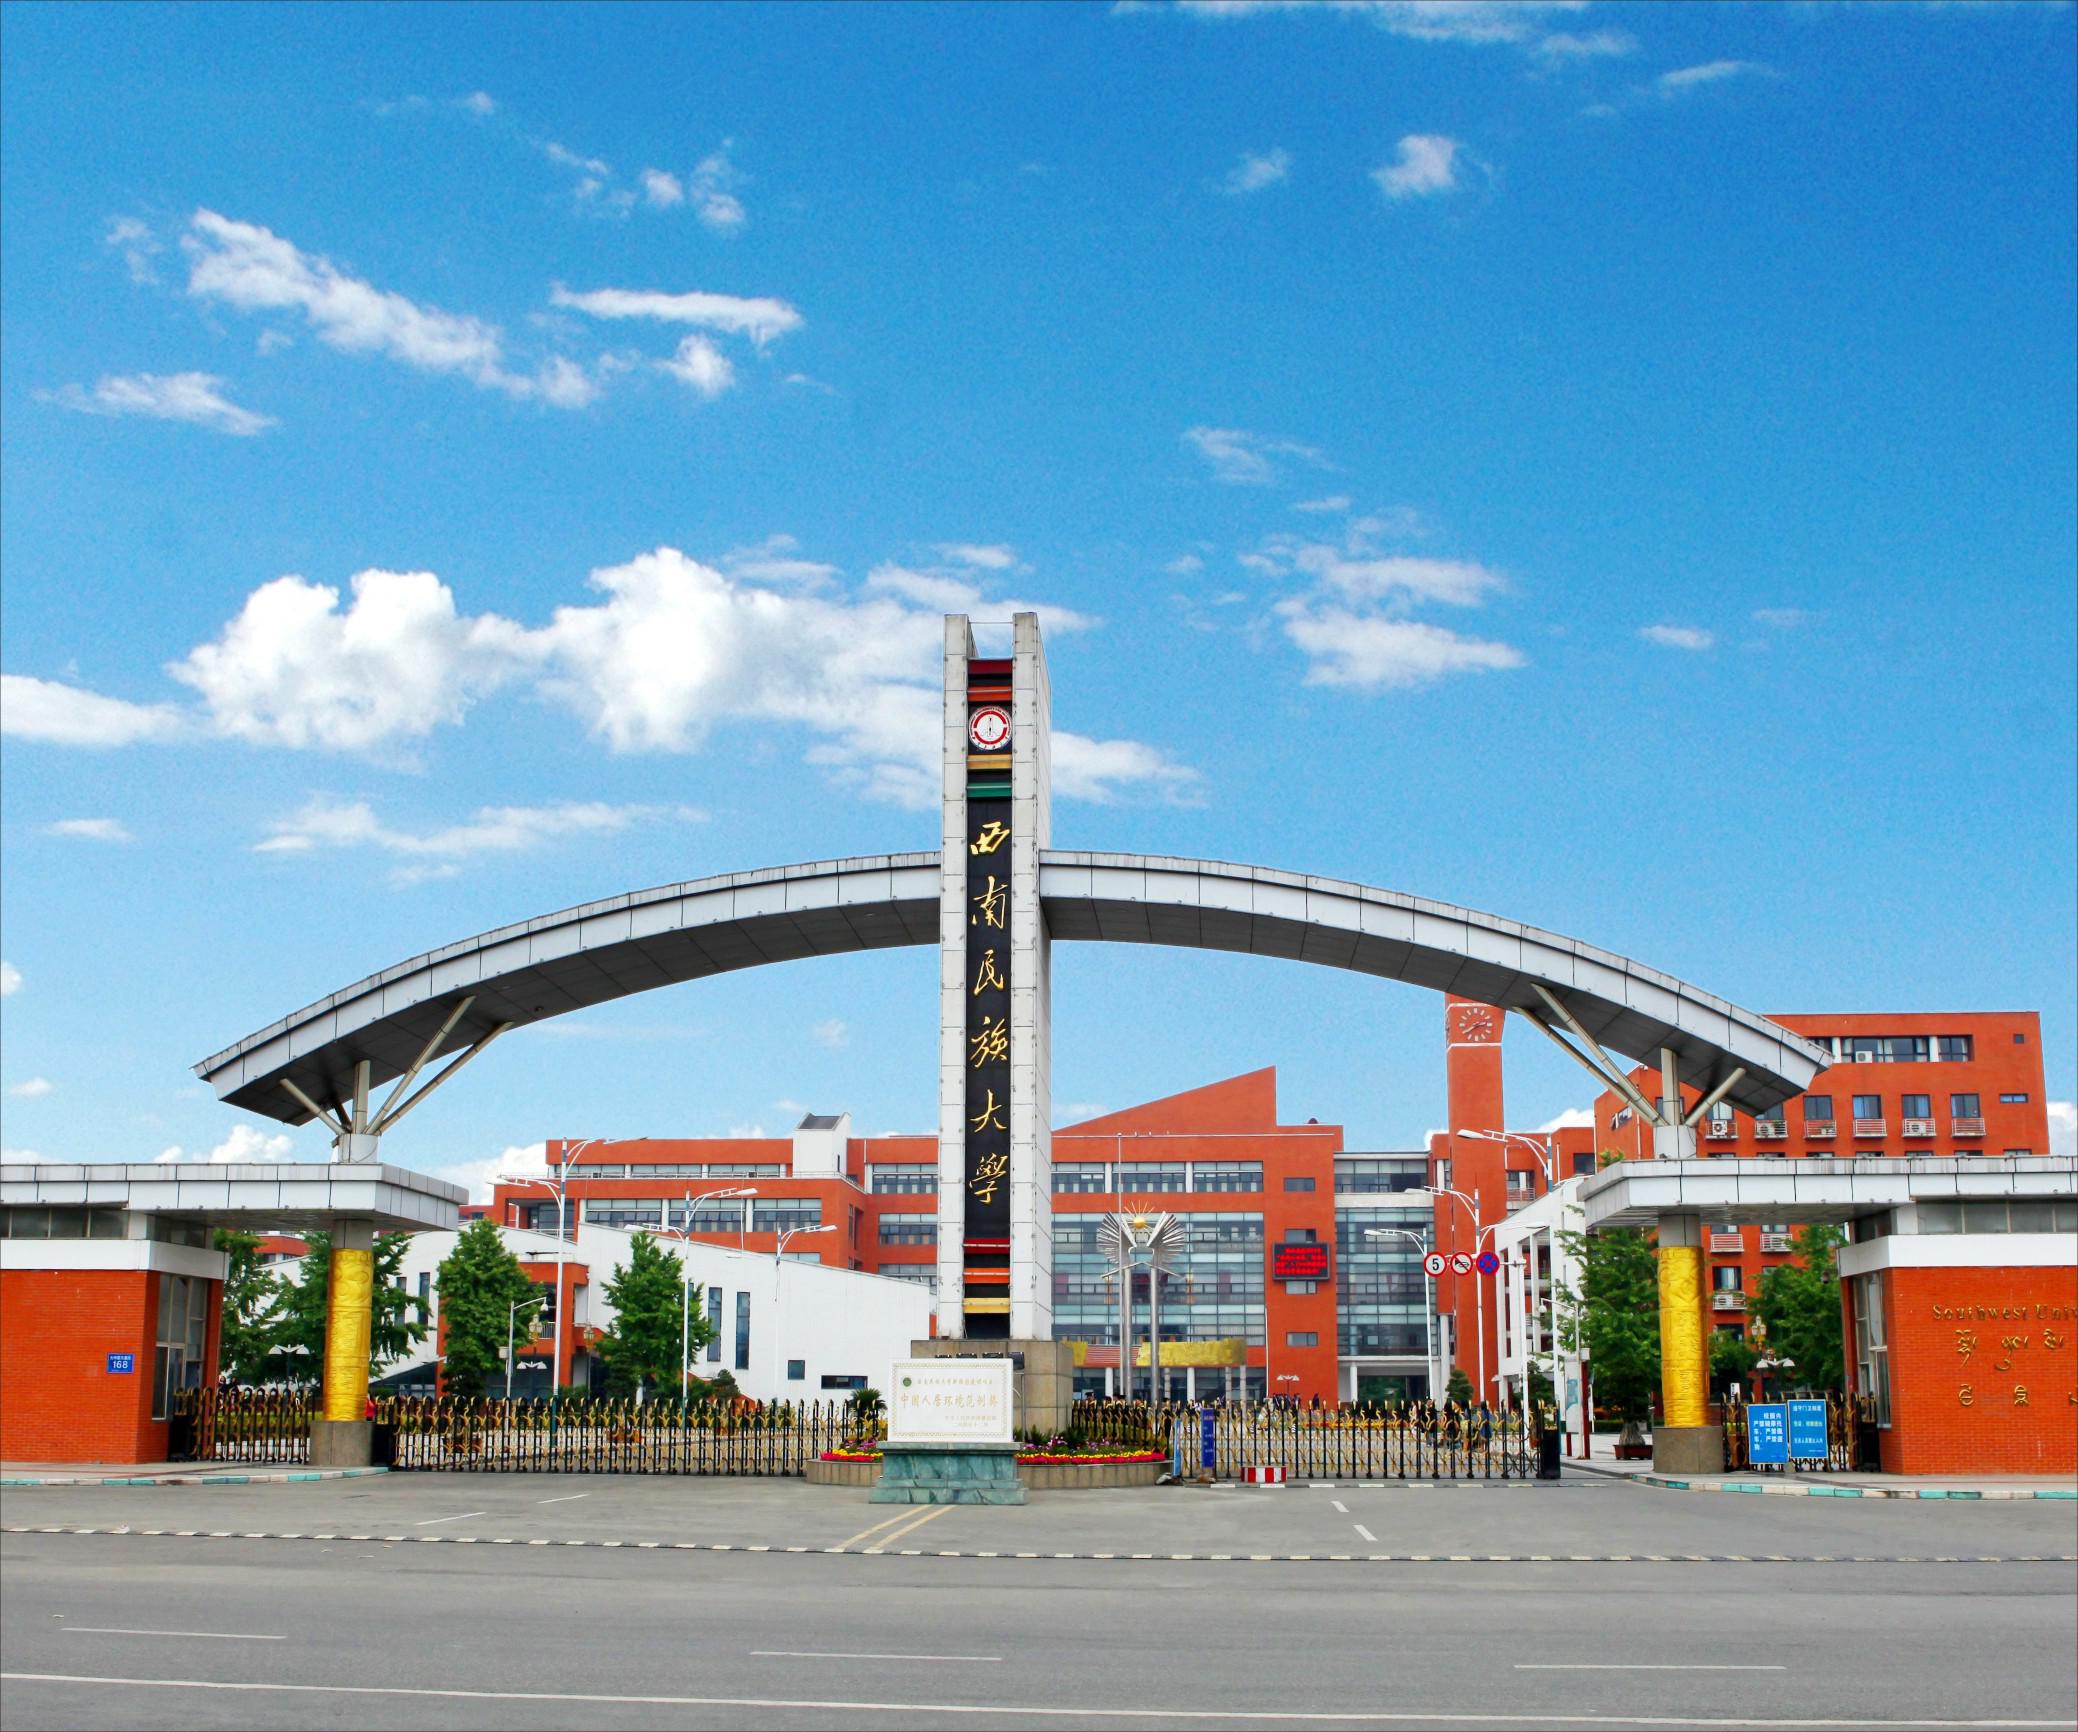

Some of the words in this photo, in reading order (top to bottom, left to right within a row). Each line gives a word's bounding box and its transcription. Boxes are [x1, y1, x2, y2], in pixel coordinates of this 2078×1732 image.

[1432, 1258, 1440, 1271] 5
[1932, 1303, 2028, 1321] Southwest
[113, 1360, 129, 1369] 168
